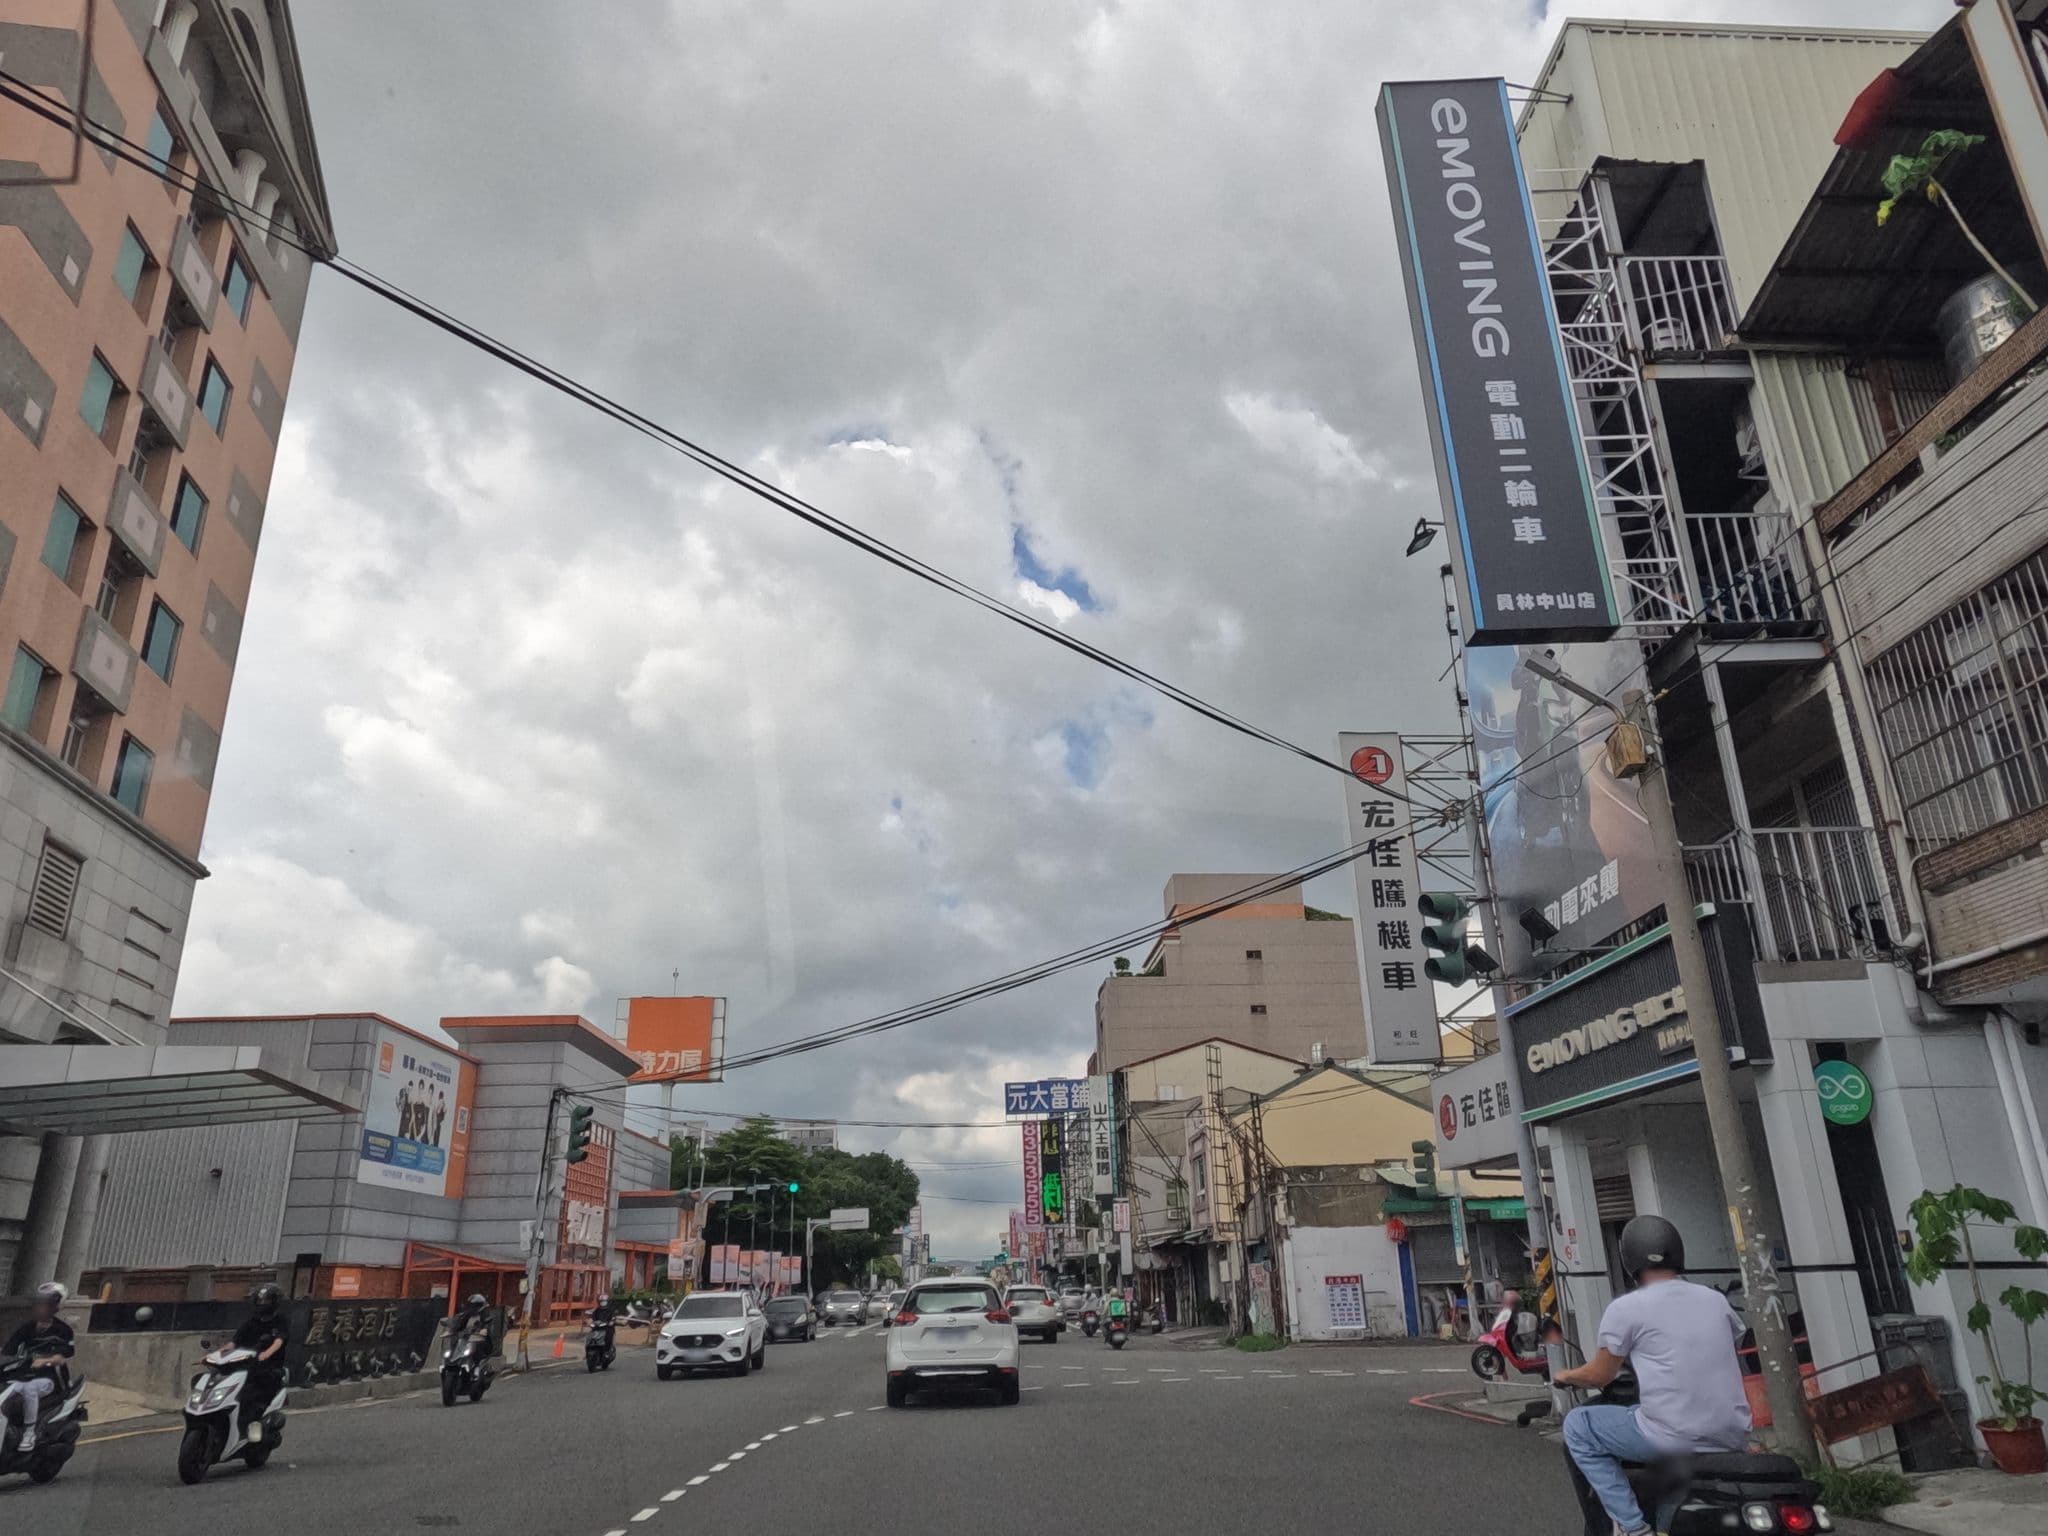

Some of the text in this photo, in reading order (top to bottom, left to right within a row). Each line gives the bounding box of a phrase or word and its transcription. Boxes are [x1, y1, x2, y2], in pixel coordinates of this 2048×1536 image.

[1430, 98, 1510, 358] eMOVING
[1484, 380, 1547, 544] 電動二輪車
[1496, 591, 1596, 612] 員林中山店
[1360, 800, 1417, 991] 宏佳騰機車
[1024, 1122, 1039, 1224] 8353555
